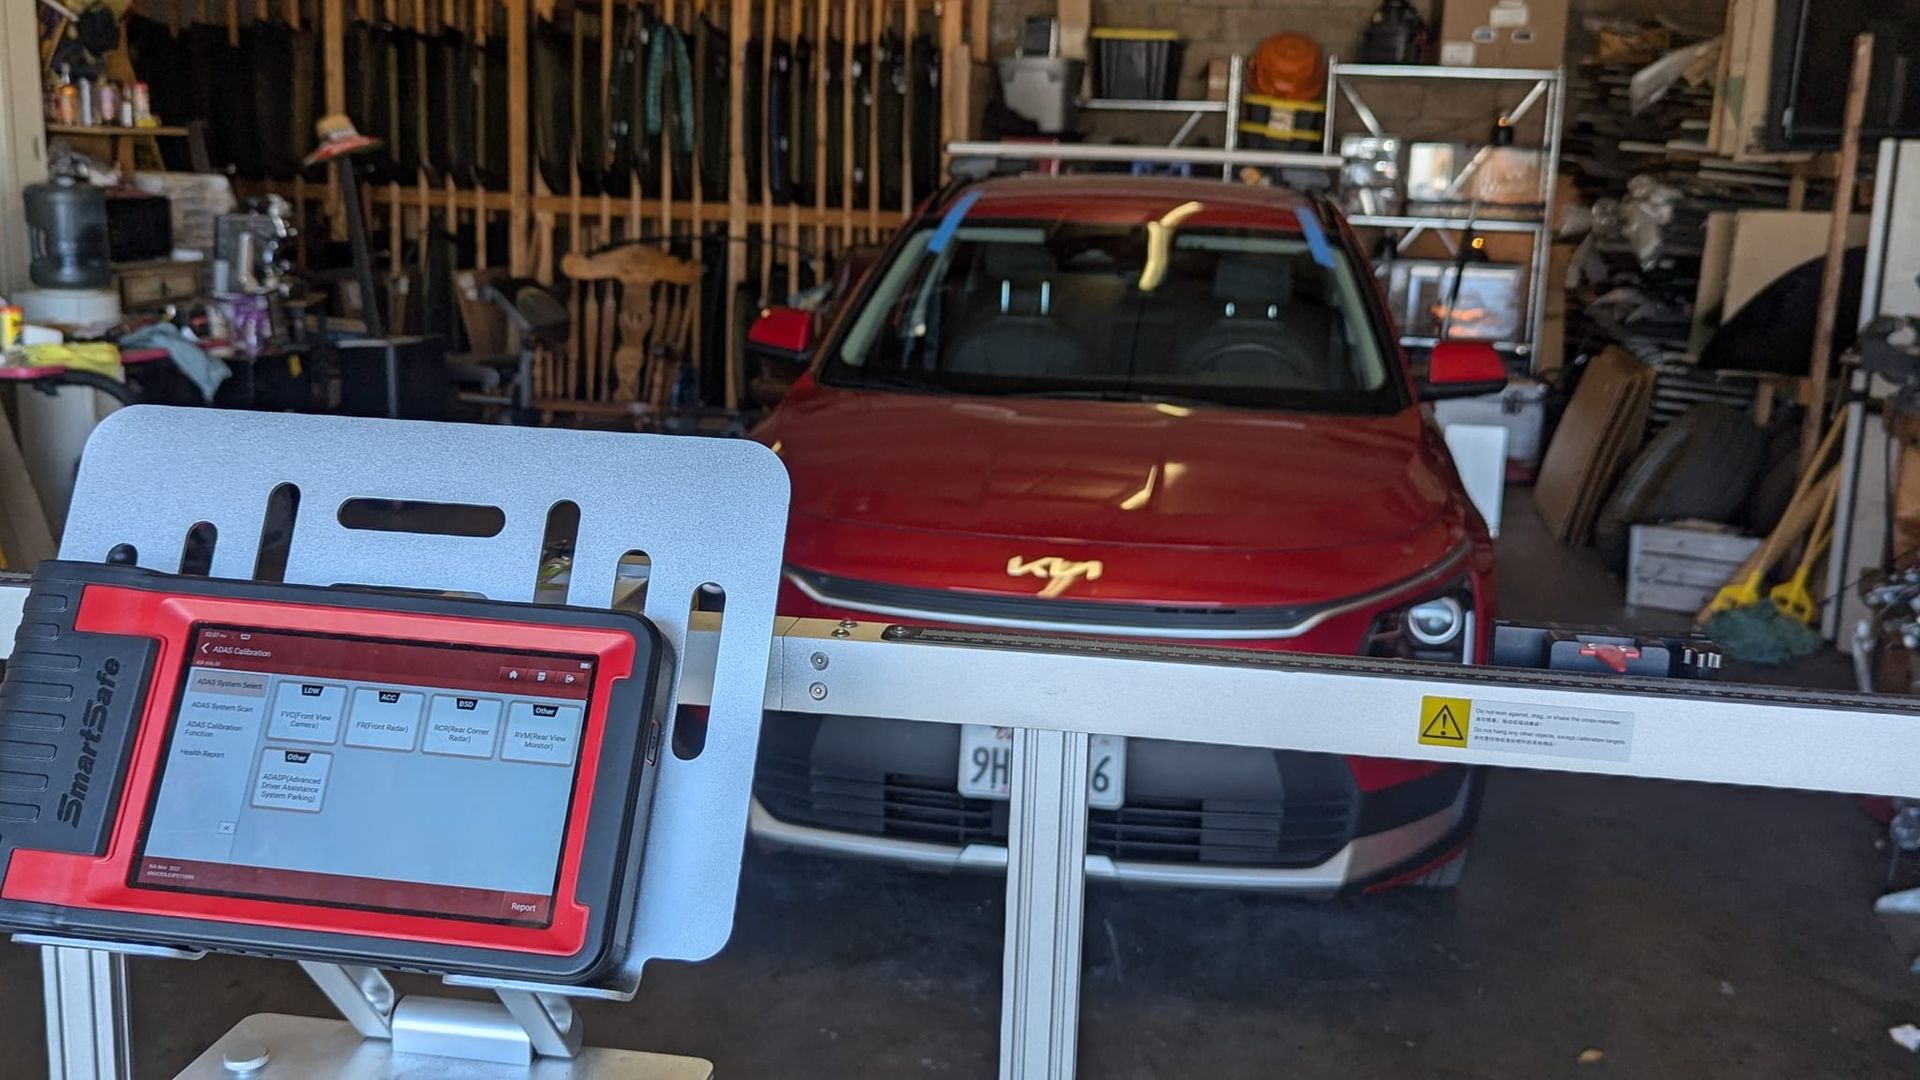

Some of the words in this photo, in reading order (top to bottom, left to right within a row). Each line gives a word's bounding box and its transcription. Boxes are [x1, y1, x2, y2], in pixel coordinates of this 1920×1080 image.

[212, 645, 234, 654] ADAS
[234, 647, 272, 657] Calibration
[196, 678, 216, 686] ADAS
[217, 680, 241, 690] System
[242, 681, 263, 690] Select
[304, 686, 321, 695] LDW
[380, 693, 397, 702] ACC
[191, 701, 210, 709] ADAS
[212, 702, 236, 712] System
[236, 705, 254, 713] Scan
[458, 700, 474, 708] BSD
[315, 713, 332, 721] View
[535, 707, 555, 716] Other
[186, 720, 206, 729] ADAS
[207, 721, 242, 732] Calibration
[290, 720, 319, 730] Camera)
[356, 721, 385, 731] FR(Front
[386, 723, 409, 733] Radar)
[434, 724, 465, 734] RCR(Rear
[466, 727, 489, 736] Corner
[184, 728, 214, 738] Function
[514, 731, 549, 741] RVM(Rear
[549, 734, 567, 742] View
[57, 656, 120, 828] SmartSafe
[449, 734, 471, 744] Radar)
[524, 741, 553, 751] Monitor)
[180, 748, 202, 757] Health
[202, 750, 224, 759] Report
[287, 753, 307, 762] Other
[262, 773, 321, 785] ADASP(Advanced
[261, 781, 281, 791] Driver
[282, 783, 319, 793] Assistance
[260, 790, 286, 800] System
[287, 792, 316, 803] Parking)
[511, 901, 537, 912] Report
